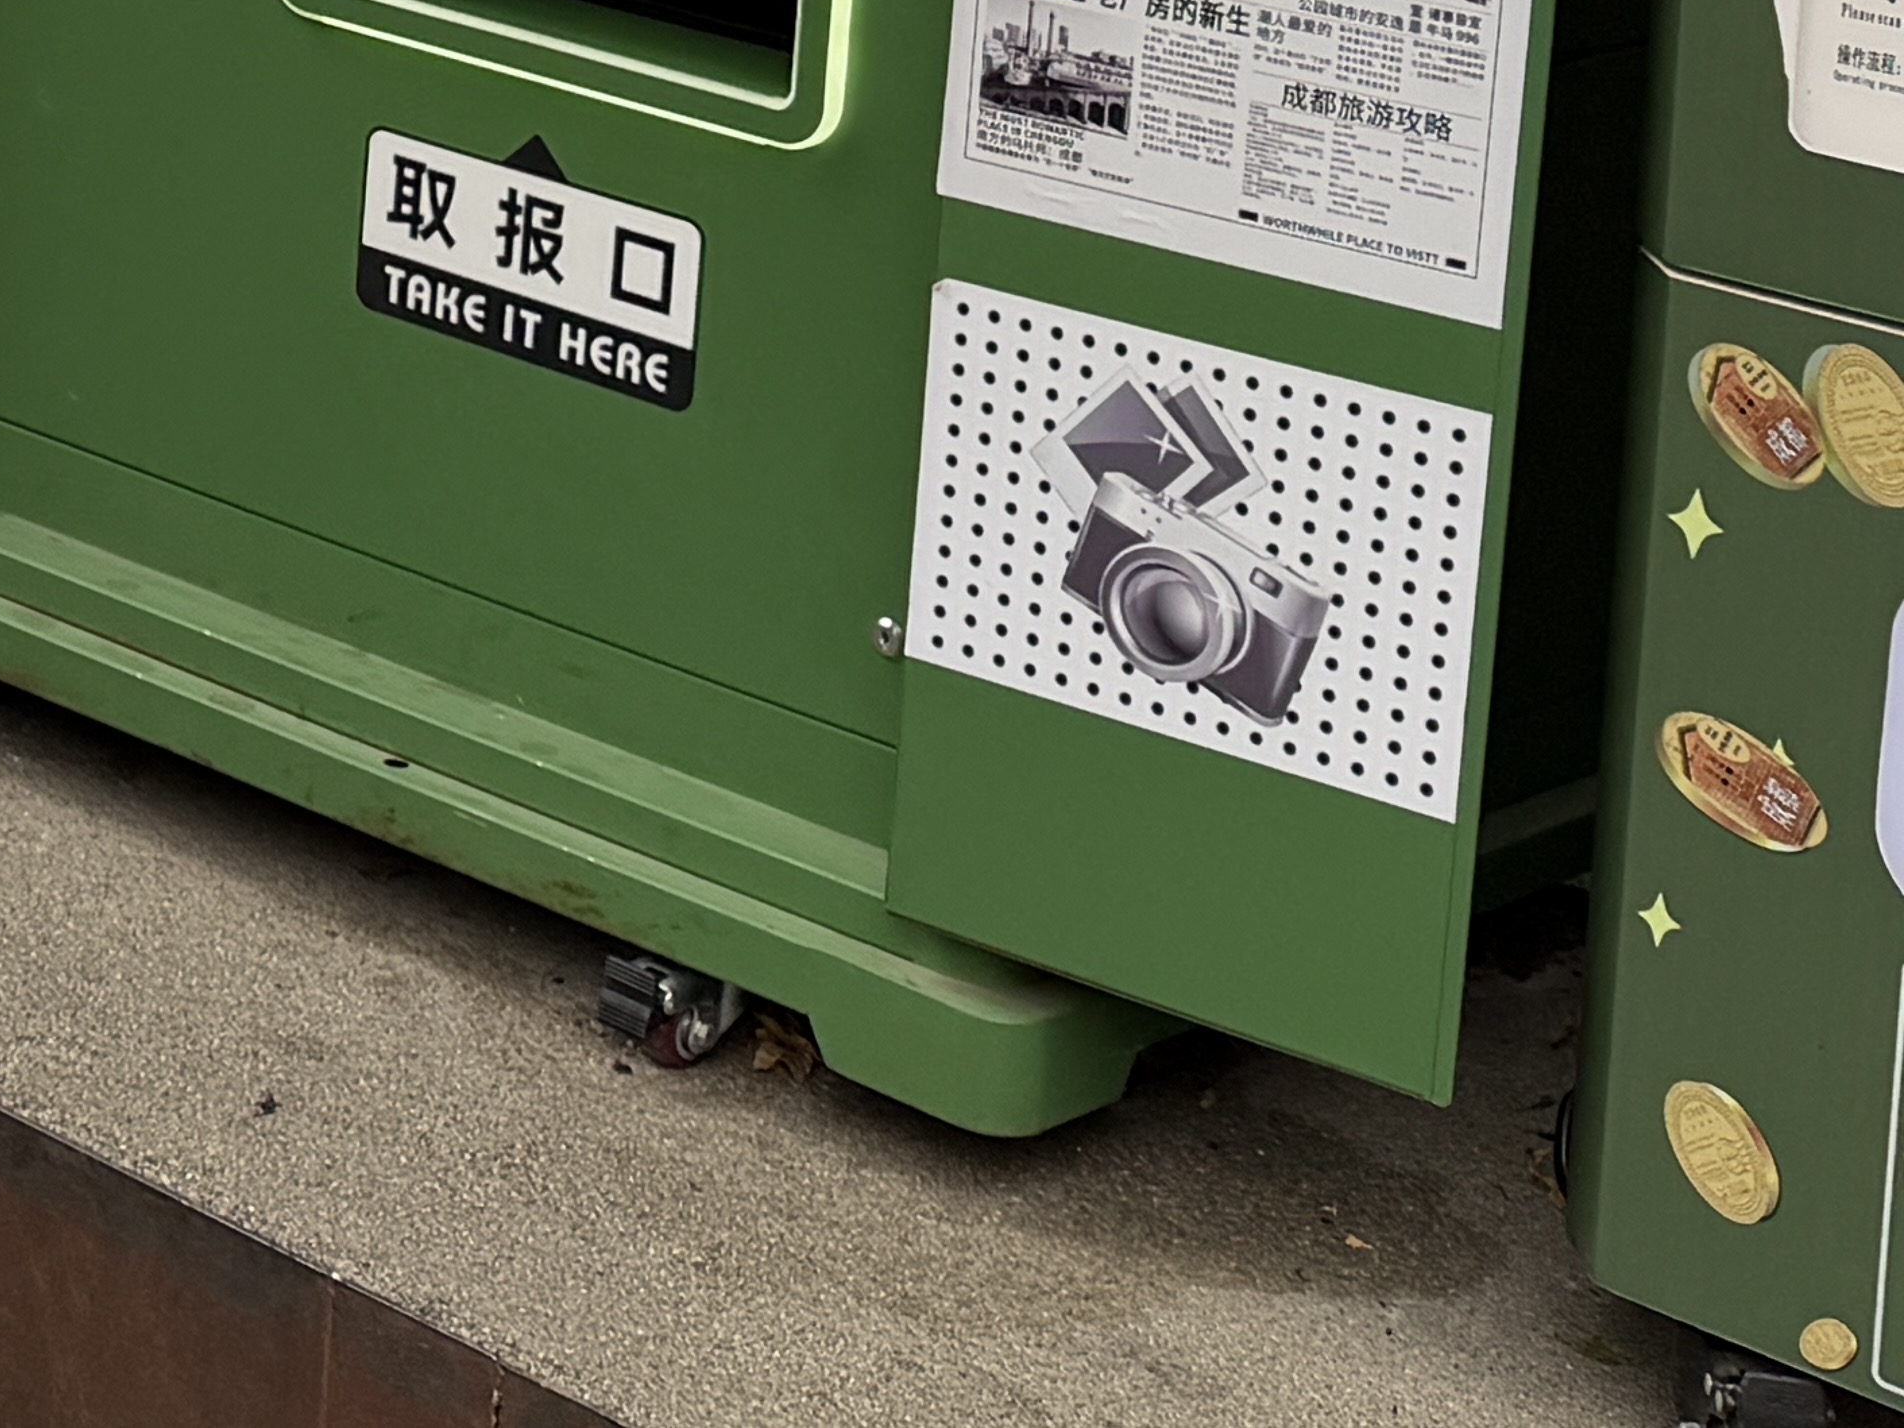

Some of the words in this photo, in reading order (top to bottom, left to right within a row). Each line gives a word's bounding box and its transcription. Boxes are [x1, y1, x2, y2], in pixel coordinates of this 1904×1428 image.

[1281, 82, 1453, 142] 成都旅游攻略
[387, 153, 676, 316] 取报口
[384, 264, 487, 333] TAKE
[502, 303, 542, 349] IT
[559, 322, 670, 394] HERE
